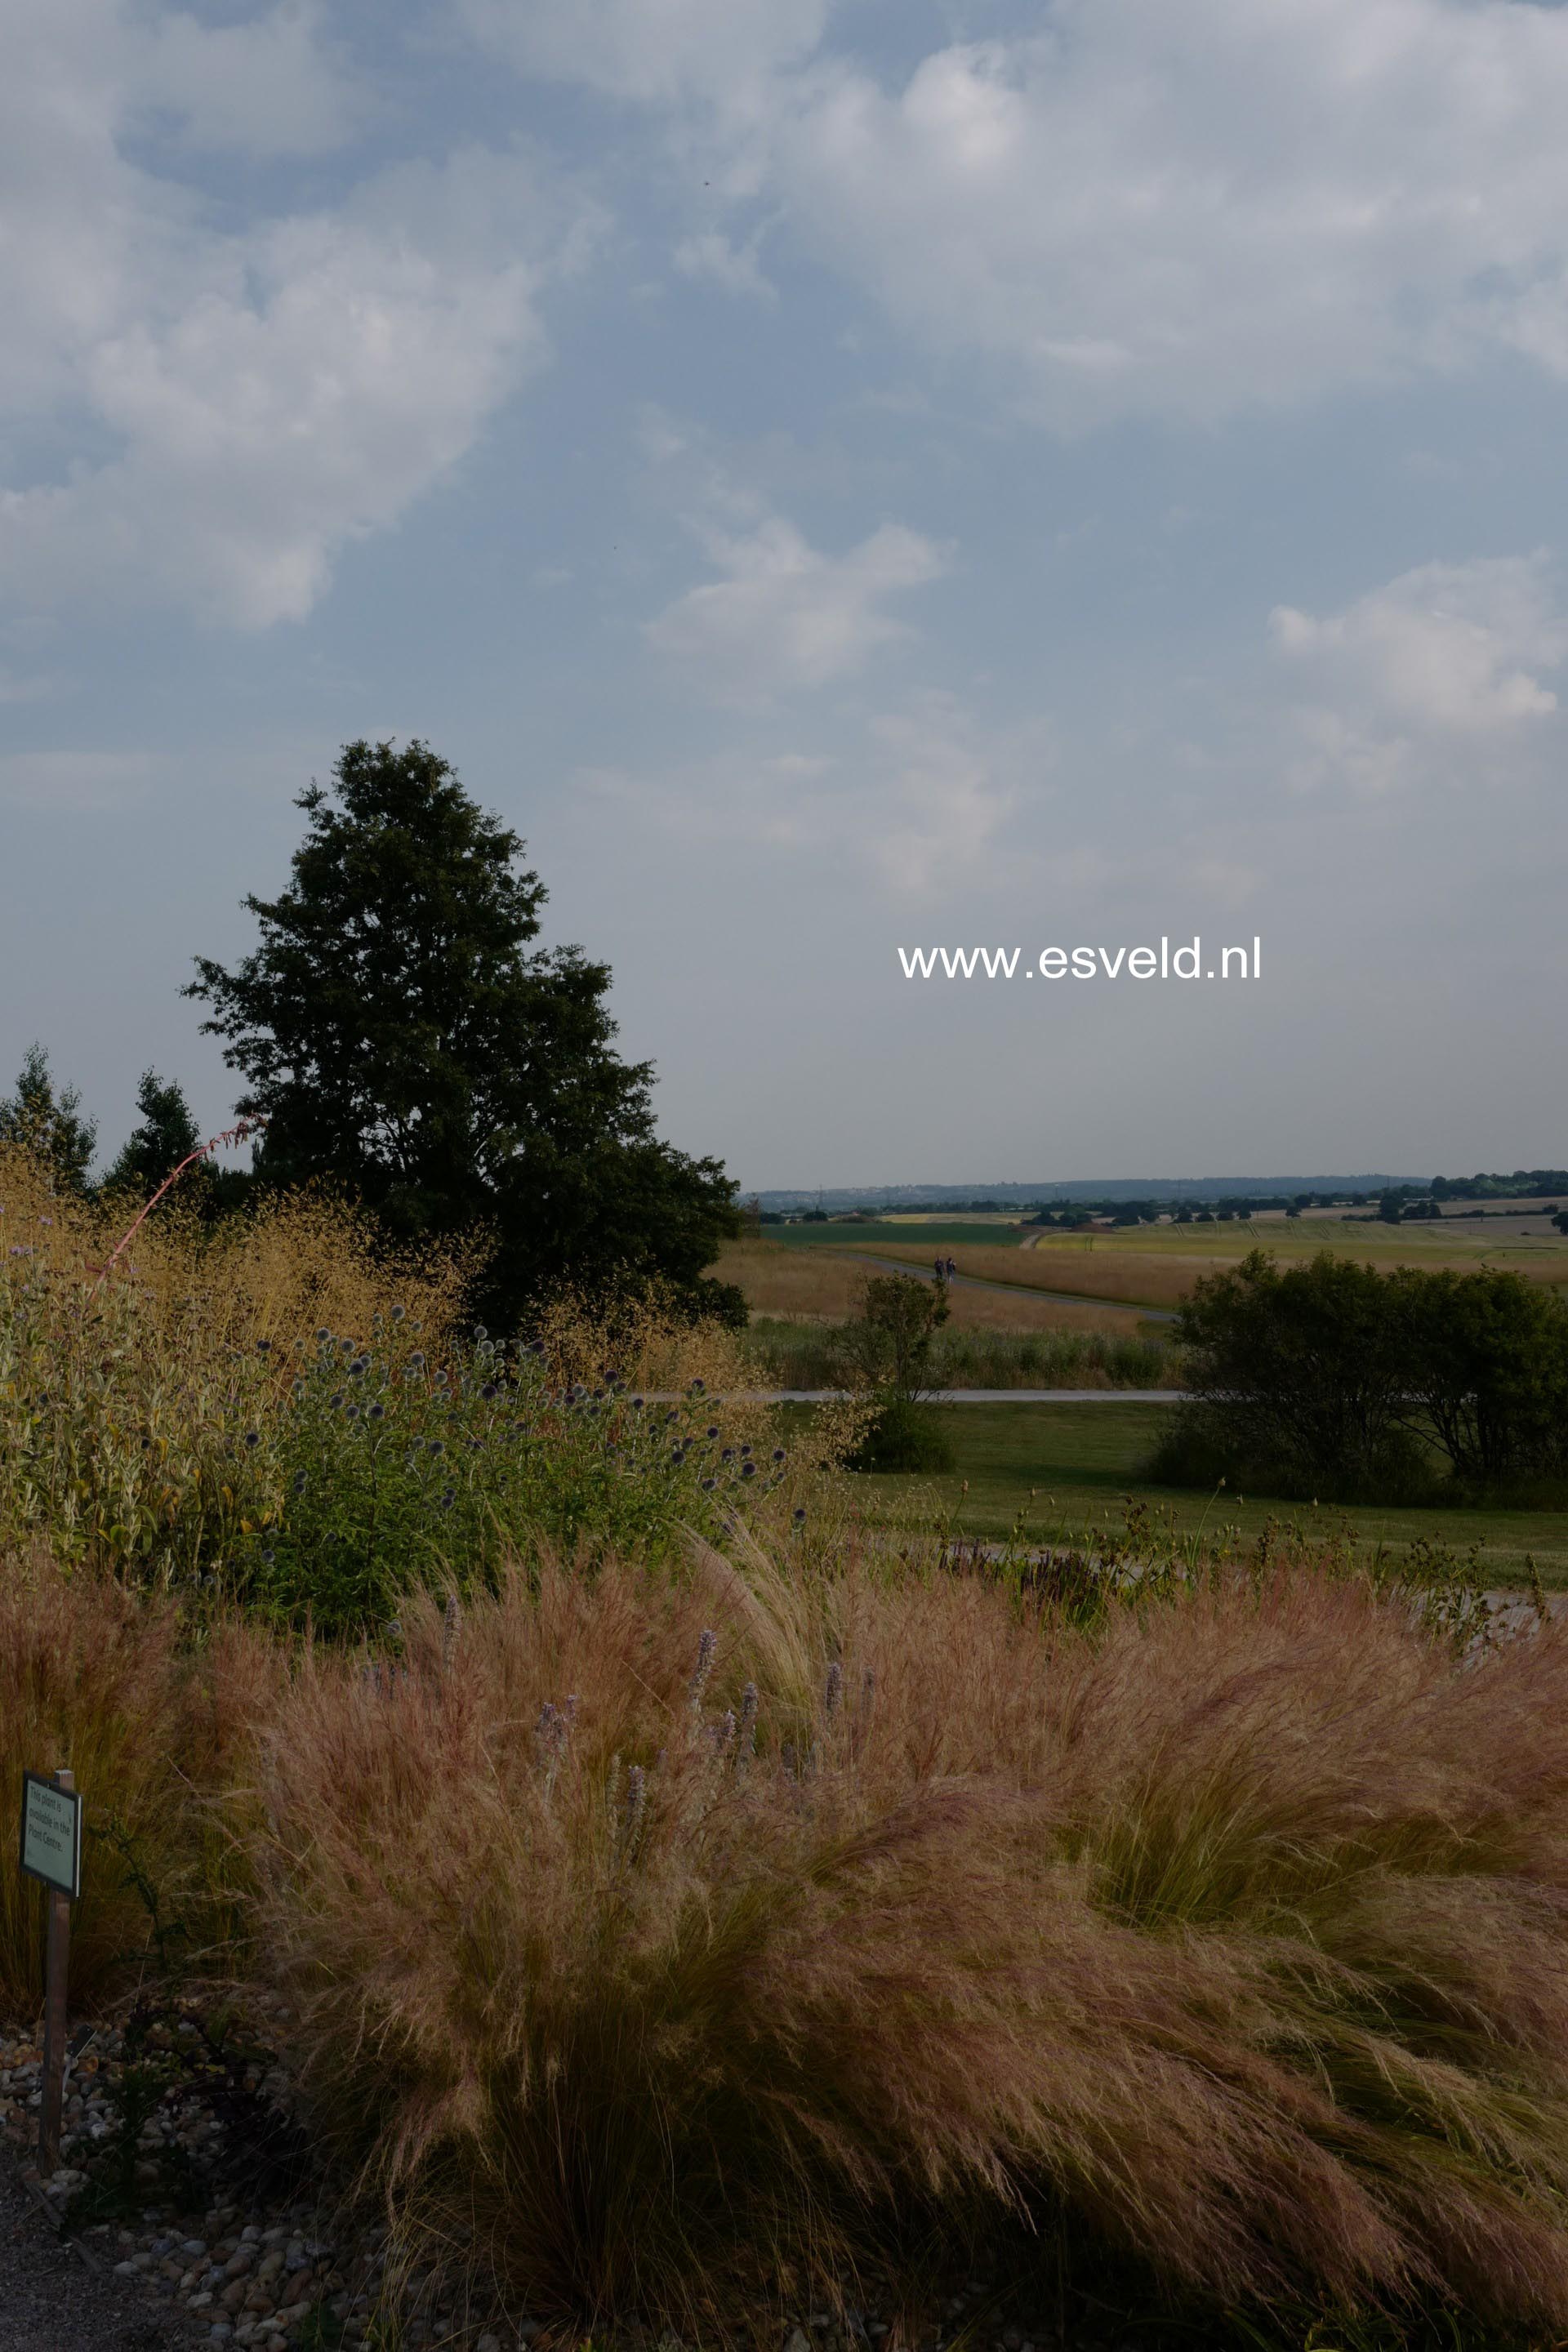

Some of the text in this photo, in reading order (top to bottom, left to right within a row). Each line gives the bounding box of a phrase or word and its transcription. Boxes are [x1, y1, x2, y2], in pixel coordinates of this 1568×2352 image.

[30, 1786, 62, 1813] This plant is
[28, 1824, 42, 1842] Plant
[53, 1818, 59, 1830] in
[60, 1822, 70, 1836] the
